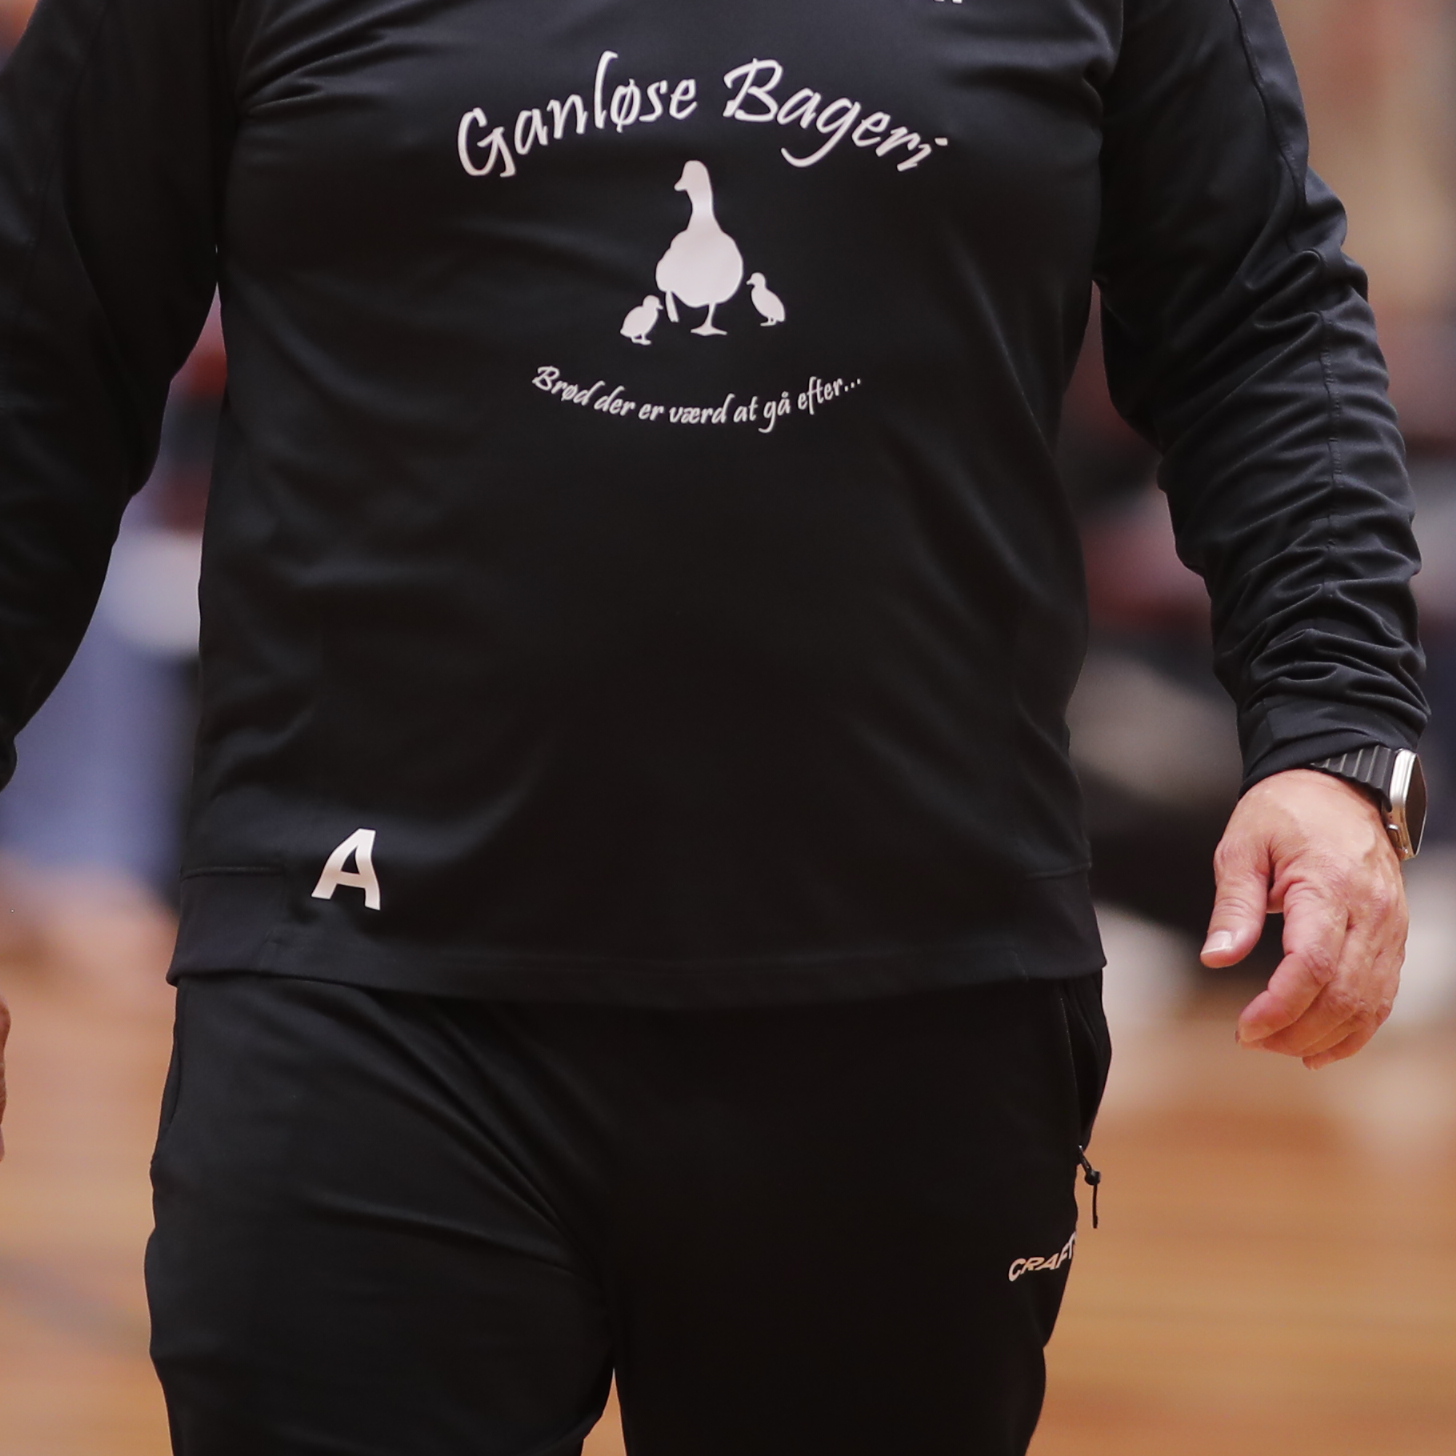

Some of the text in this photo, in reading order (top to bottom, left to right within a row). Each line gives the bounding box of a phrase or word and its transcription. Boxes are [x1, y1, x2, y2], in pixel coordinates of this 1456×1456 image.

[458, 51, 947, 177] Ganløse Bageri
[532, 366, 860, 433] Brød der er værd at gå efter...
[312, 829, 380, 910] A
